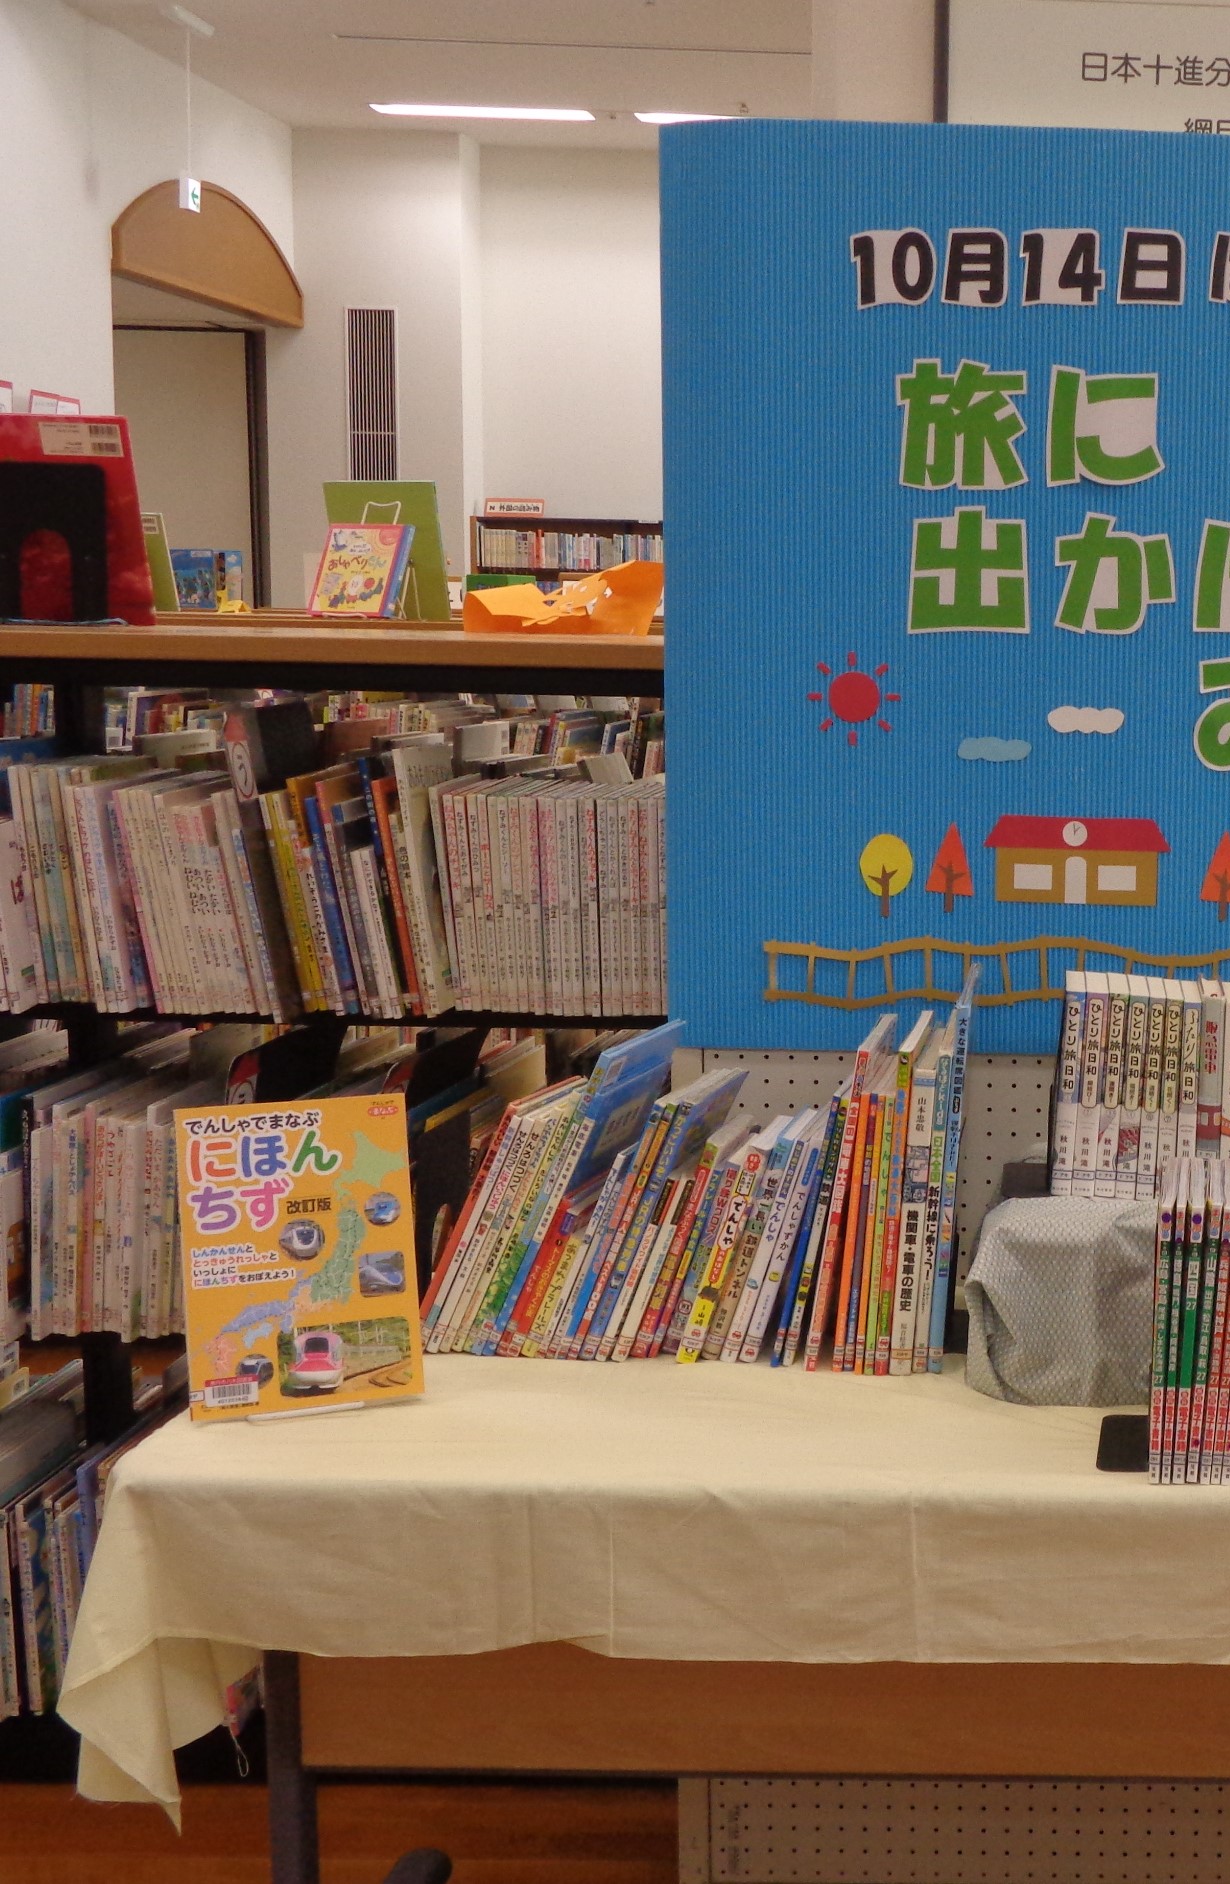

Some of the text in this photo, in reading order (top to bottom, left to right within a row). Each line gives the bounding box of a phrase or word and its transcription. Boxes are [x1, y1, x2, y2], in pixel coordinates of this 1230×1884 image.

[896, 361, 1161, 488] 旅に
[1063, 1006, 1079, 1090] ひとり旅日和
[1086, 1003, 1102, 1076] ひとり旅日和
[1107, 1003, 1124, 1076] ひとり旅日和
[1128, 1006, 1145, 1079] ひとり旅日和
[1149, 1008, 1163, 1080] ひとり旅日和
[1165, 1009, 1179, 1082] ひとり旅日和
[185, 1112, 320, 1135] でんしゃでまなぶ
[914, 1097, 926, 1132] 山本忠敬
[190, 1131, 338, 1182] にほん
[880, 1132, 891, 1195] でんしゃ
[930, 1134, 943, 1182] 日本全国
[191, 1178, 289, 1230] ちず
[286, 1197, 332, 1215] 改訂版
[721, 1200, 743, 1247] でんしゃ
[764, 1199, 785, 1243] でんしゃ
[775, 1191, 805, 1262] でんしゃずかん
[192, 1245, 253, 1257] しんかんせんと
[193, 1253, 277, 1267] とっきゅうれっしゃと
[726, 1175, 779, 1300] 世界一長い鉄道トンネル
[899, 1208, 918, 1312] 機関車・電車の歴史
[194, 1266, 236, 1277] いっしょに
[1186, 1261, 1199, 1297] 四国
[1186, 1300, 1196, 1310] 27
[1154, 1374, 1163, 1383] 27
[1197, 1370, 1206, 1380] 27
[1210, 1374, 1219, 1384] 27
[1221, 1375, 1230, 1385] 27
